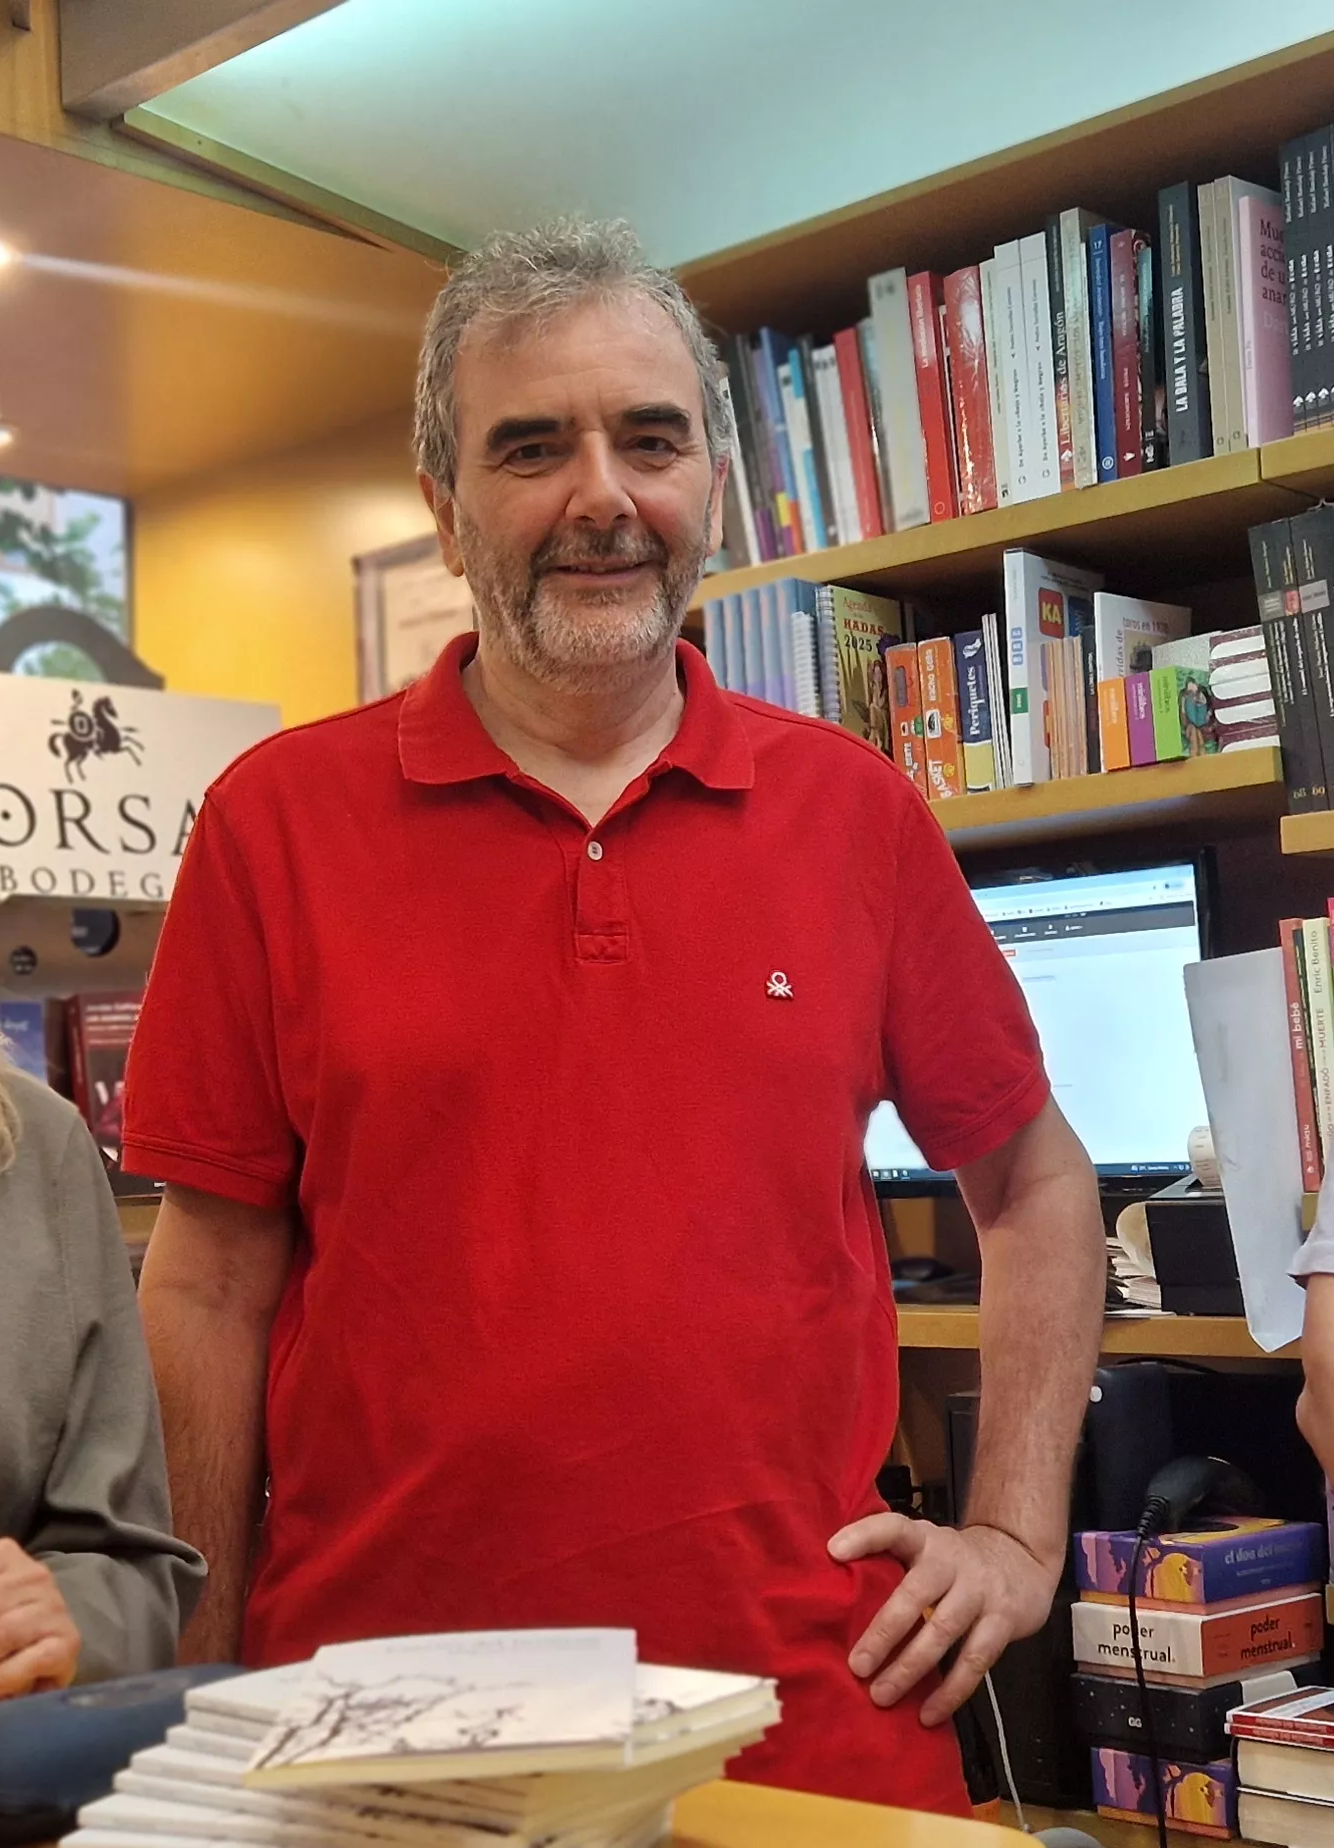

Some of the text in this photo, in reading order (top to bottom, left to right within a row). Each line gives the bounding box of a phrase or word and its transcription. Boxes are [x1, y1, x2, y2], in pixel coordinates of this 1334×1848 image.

[1173, 287, 1186, 336] PALABRA
[1174, 338, 1187, 354] LA
[1175, 356, 1187, 364] Y
[1055, 312, 1071, 445] Libertarios de Aragón
[1175, 366, 1188, 396] BALA
[1176, 397, 1188, 412] LA
[1041, 603, 1063, 624] KA
[1123, 617, 1142, 629] toros
[844, 618, 884, 636] HADAS
[845, 634, 873, 652] 2025
[964, 665, 986, 737] Periquetes
[1308, 930, 1323, 994] Enric Benito
[1289, 1002, 1304, 1050] mi bebé
[1316, 1008, 1332, 1105] ENFADÓ MUERTE
[1236, 1549, 1256, 1563] don
[1251, 1617, 1280, 1638] poder
